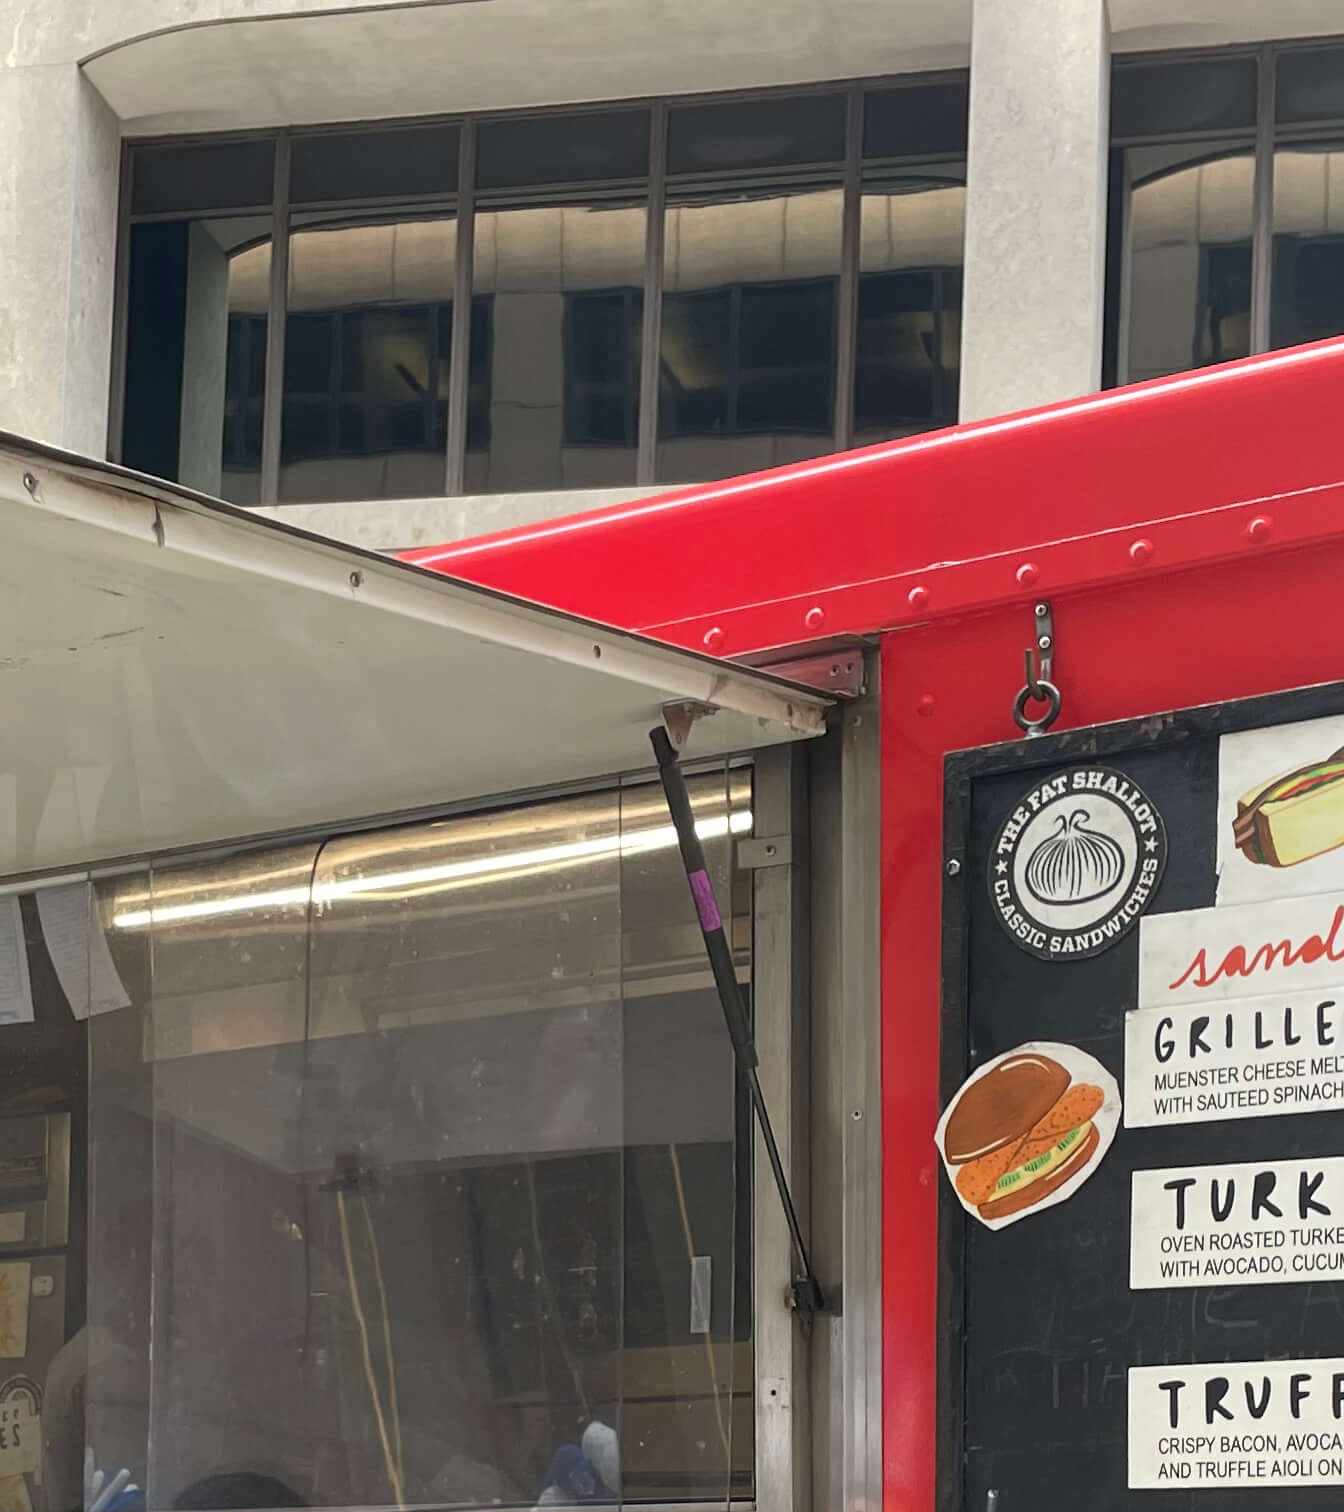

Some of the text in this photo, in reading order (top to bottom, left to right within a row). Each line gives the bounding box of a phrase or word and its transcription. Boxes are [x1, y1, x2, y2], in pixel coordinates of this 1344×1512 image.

[997, 771, 1159, 855] THE FAT SHALLOT
[994, 858, 1158, 953] CLASSIC SANDWICHES
[1154, 1065, 1239, 1091] MUENSTER
[1243, 1058, 1305, 1082] CHEESE
[1154, 1094, 1193, 1115] WITH
[1196, 1087, 1269, 1111] SAUTEED
[1273, 1080, 1344, 1104] SPINACH
[1160, 1233, 1205, 1254] OVEN
[1209, 1228, 1285, 1250] ROASTED
[1159, 1258, 1200, 1278] WITH
[1203, 1253, 1287, 1276] AVOCADO,
[1158, 1435, 1216, 1455] CRISPY
[1220, 1434, 1284, 1458] BACON,
[1158, 1460, 1192, 1479] AND
[1196, 1458, 1266, 1478] TRUFFLE
[1271, 1457, 1313, 1477] AIOLI
[1318, 1457, 1342, 1476] ON
